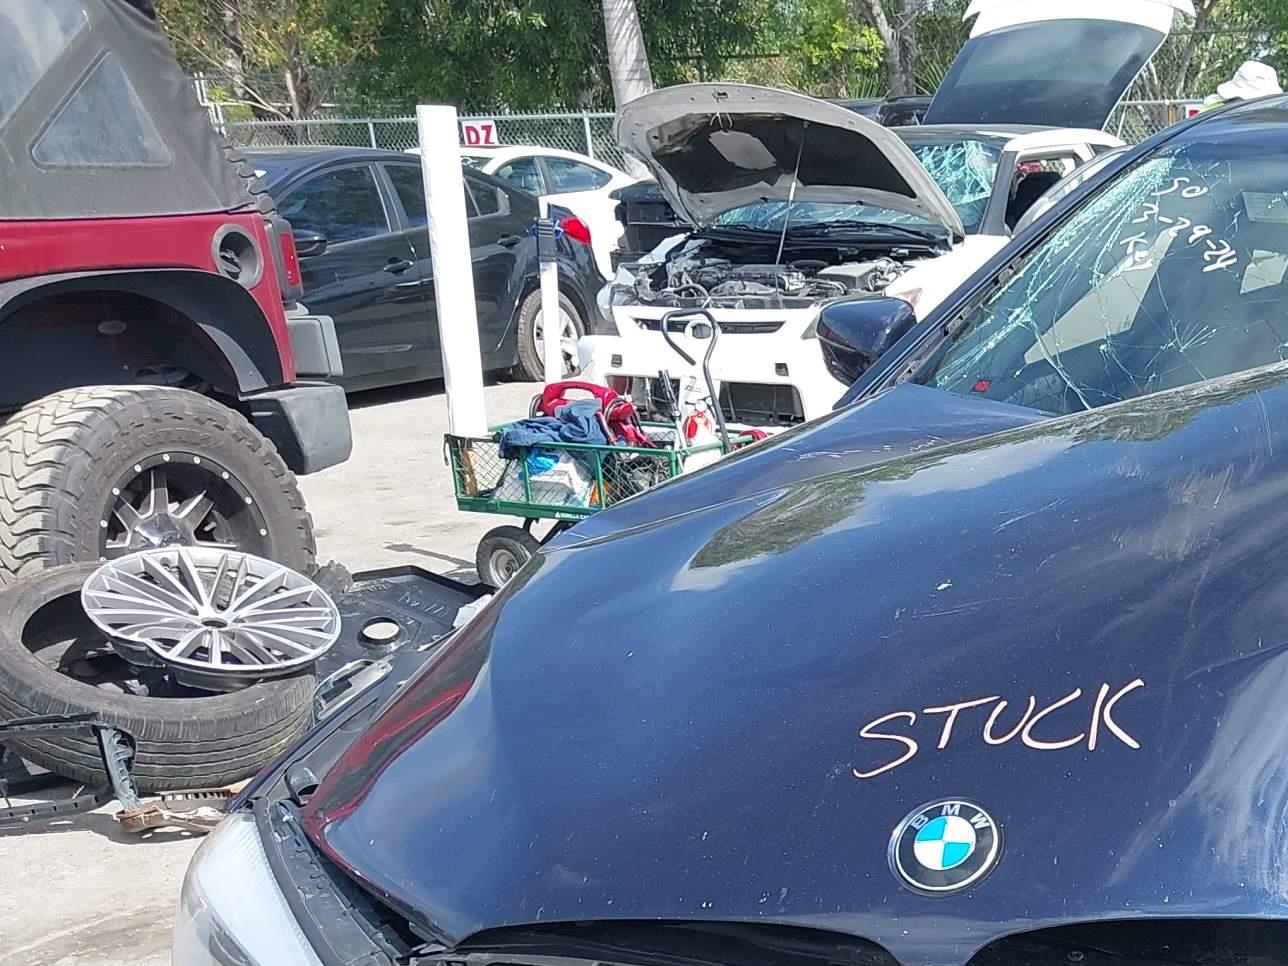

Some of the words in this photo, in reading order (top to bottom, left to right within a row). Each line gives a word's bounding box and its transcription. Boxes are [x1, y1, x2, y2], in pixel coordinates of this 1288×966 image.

[464, 125, 495, 145] DZ
[853, 678, 1145, 778] STUCK
[910, 803, 991, 830] BMW
